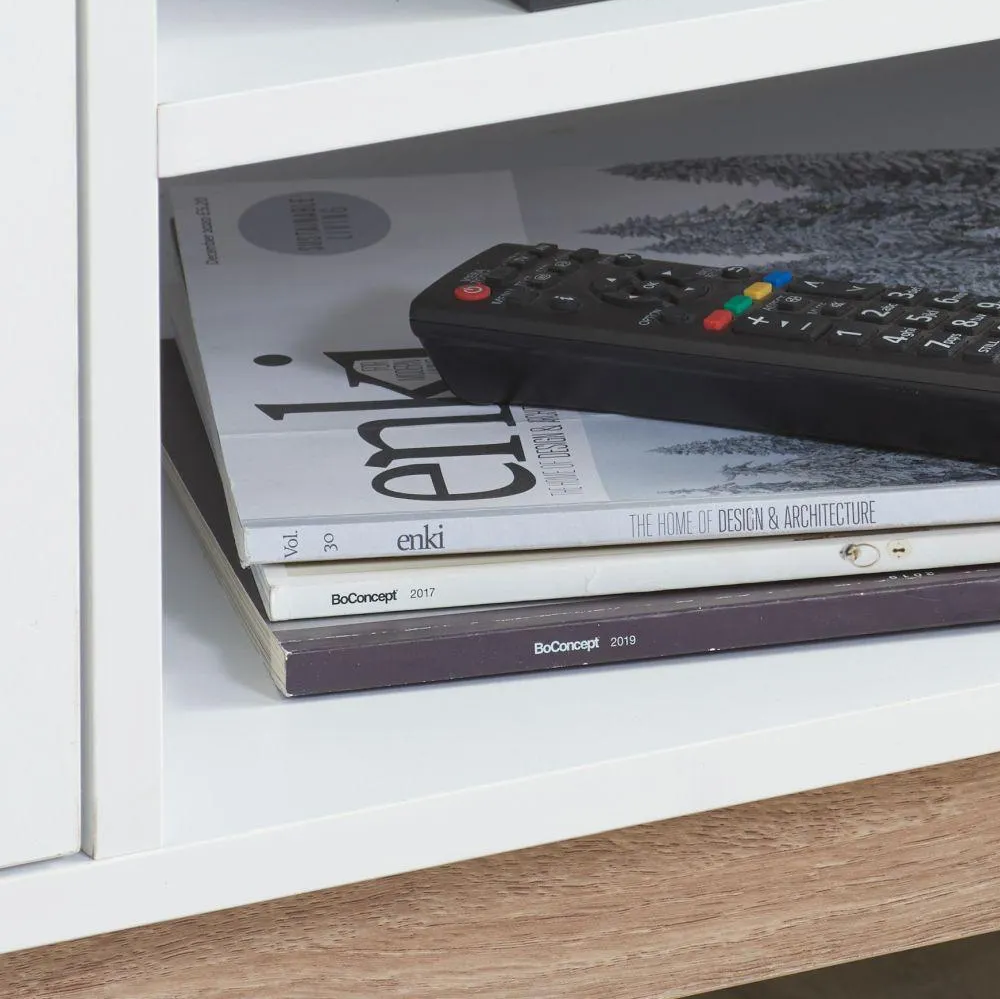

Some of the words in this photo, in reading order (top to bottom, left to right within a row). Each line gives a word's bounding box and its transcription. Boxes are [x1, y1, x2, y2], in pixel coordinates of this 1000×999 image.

[532, 433, 571, 459] DESIGN
[629, 513, 653, 538] THE
[657, 511, 693, 537] HOME
[698, 509, 713, 534] OF
[718, 507, 764, 533] DESIGN
[768, 506, 780, 530] &
[784, 500, 877, 530] ARCHITECTURE
[283, 530, 299, 558] Vol.
[323, 532, 339, 552] 30
[397, 524, 446, 551] enki
[331, 589, 398, 606] BoConcept
[410, 588, 436, 599] 2017
[534, 637, 600, 655] BoConcept
[610, 635, 637, 648] 2019
